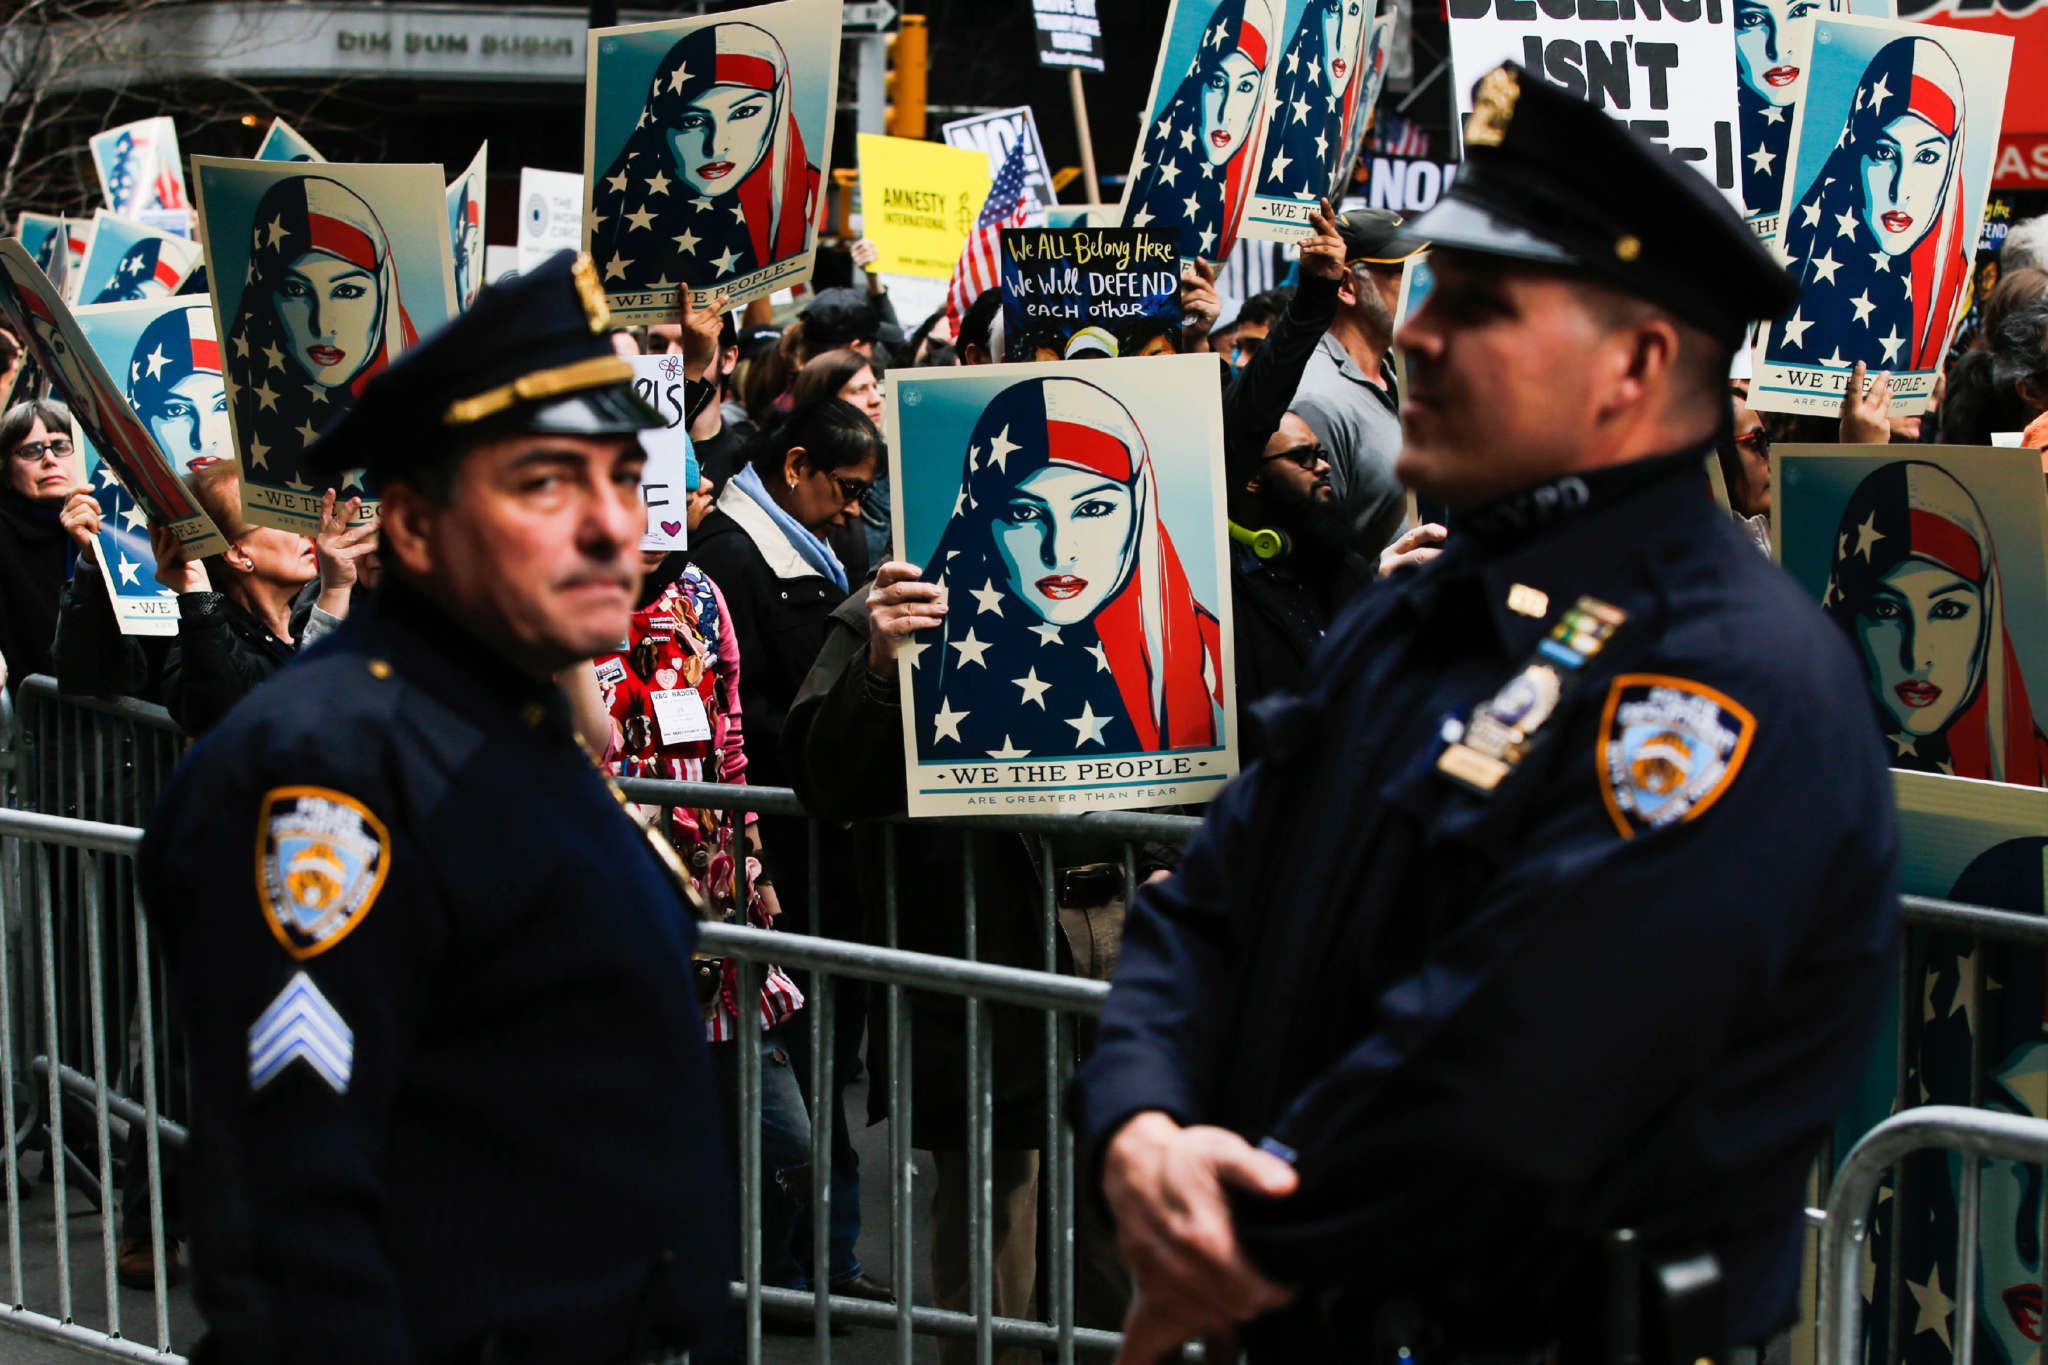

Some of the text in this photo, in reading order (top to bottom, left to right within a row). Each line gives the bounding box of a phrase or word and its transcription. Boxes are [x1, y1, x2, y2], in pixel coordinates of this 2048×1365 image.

[1523, 35, 1678, 110] ISN'T
[884, 187, 945, 213] AMNESTY
[1271, 203, 1297, 218] WE
[1008, 234, 1034, 262] We
[1038, 233, 1072, 260] ALL
[616, 262, 787, 307] WE TE PEOPLE
[1005, 269, 1035, 298] We
[1037, 267, 1082, 297] Will
[1786, 370, 1825, 389] WE
[1887, 377, 1921, 393] EOPLE
[264, 490, 296, 509] WE
[139, 602, 171, 614] WE
[951, 757, 1192, 784] WE THE PEOPLE
[967, 787, 1178, 805] ARE GREATER THAN FEAR
